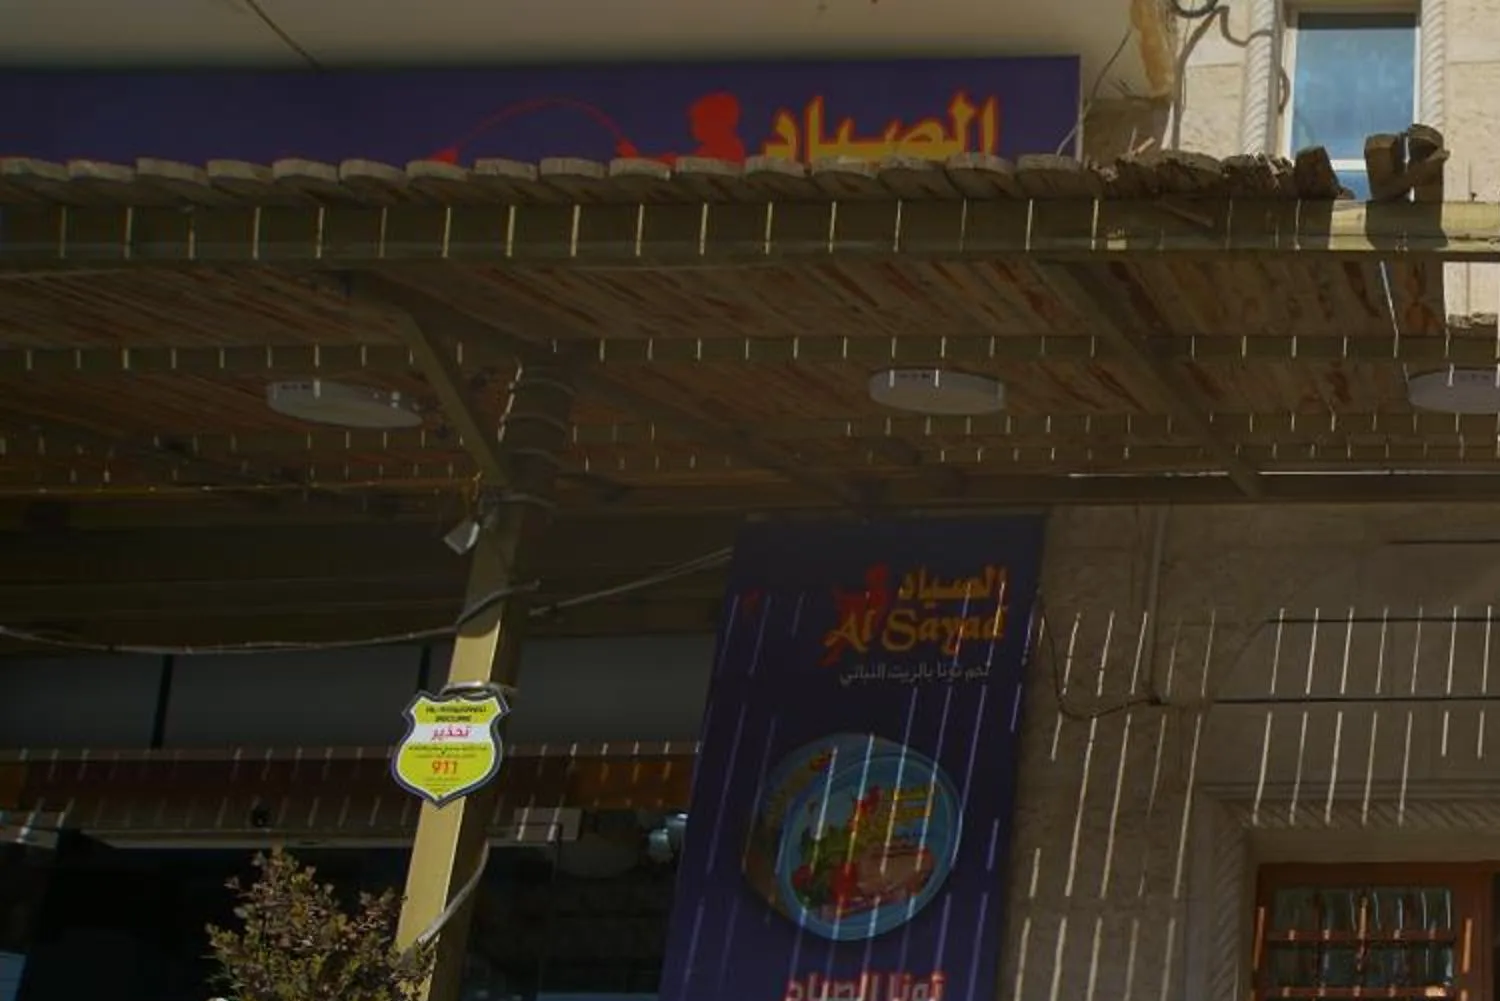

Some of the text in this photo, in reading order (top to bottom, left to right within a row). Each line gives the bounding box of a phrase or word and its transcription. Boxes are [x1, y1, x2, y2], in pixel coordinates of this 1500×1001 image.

[762, 90, 1001, 162] الصياد
[897, 563, 1009, 610] الصياد
[822, 604, 1009, 656] Al Sayad
